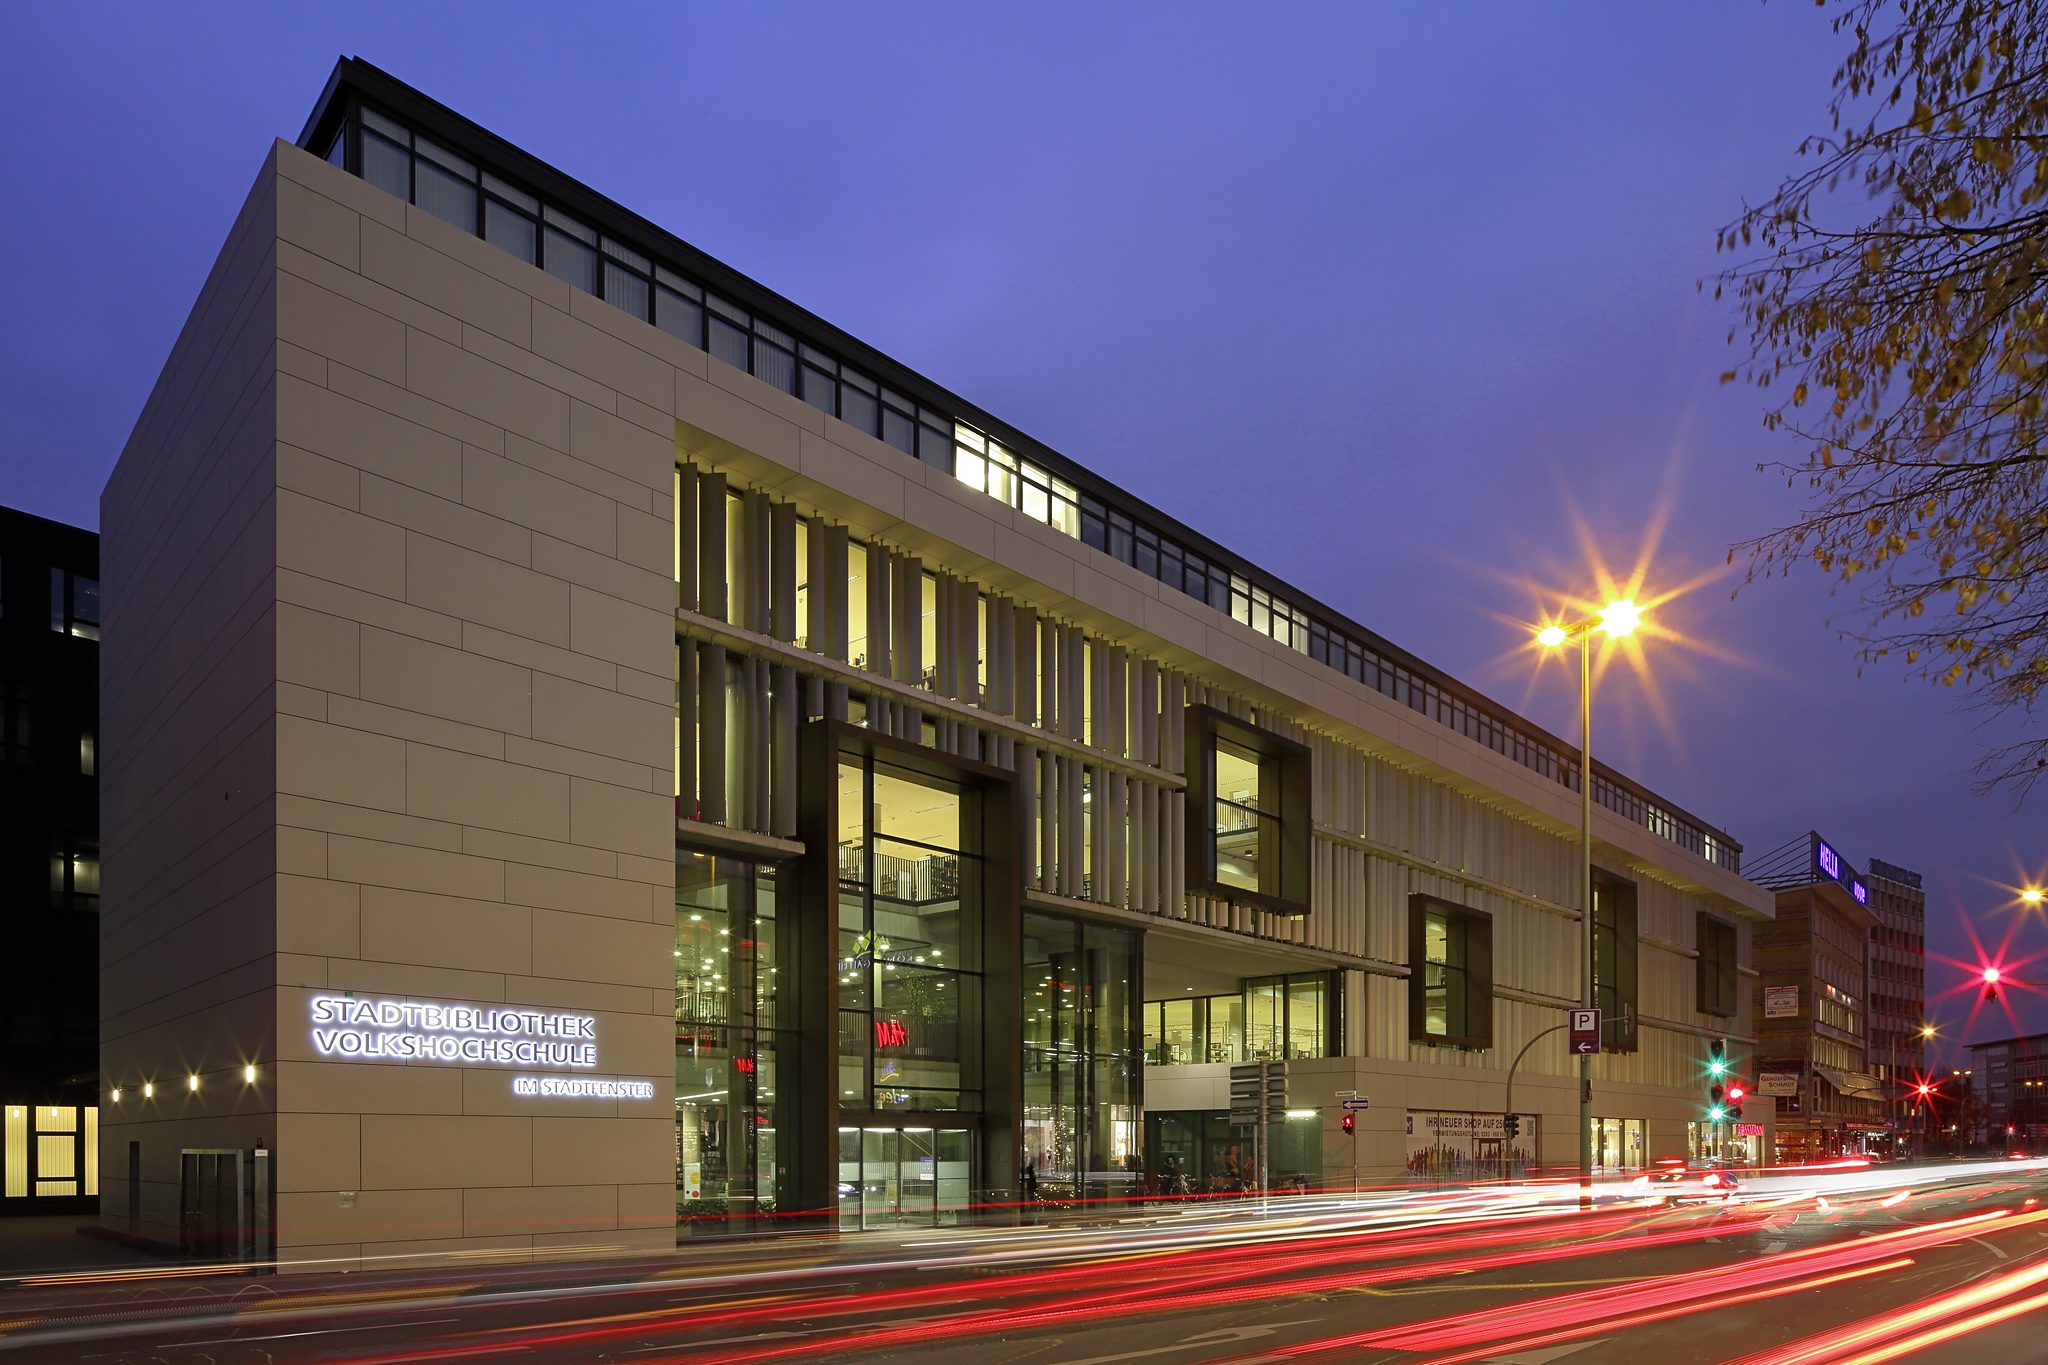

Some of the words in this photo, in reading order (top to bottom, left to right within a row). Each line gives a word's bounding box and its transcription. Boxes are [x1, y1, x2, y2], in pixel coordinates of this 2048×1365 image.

[1820, 842, 1839, 880] HELLA
[312, 998, 596, 1039] STADTBIBLIOTHEK
[1579, 1014, 1590, 1028] P
[314, 1029, 597, 1066] VOLKSHOCHSCHULE
[515, 1078, 538, 1095] IM
[542, 1079, 654, 1098] STADTFENSTER
[1426, 1117, 1438, 1128] IHR
[1440, 1118, 1462, 1128] NEUER
[1464, 1119, 1481, 1129] SHOP
[1483, 1119, 1495, 1129] AUF
